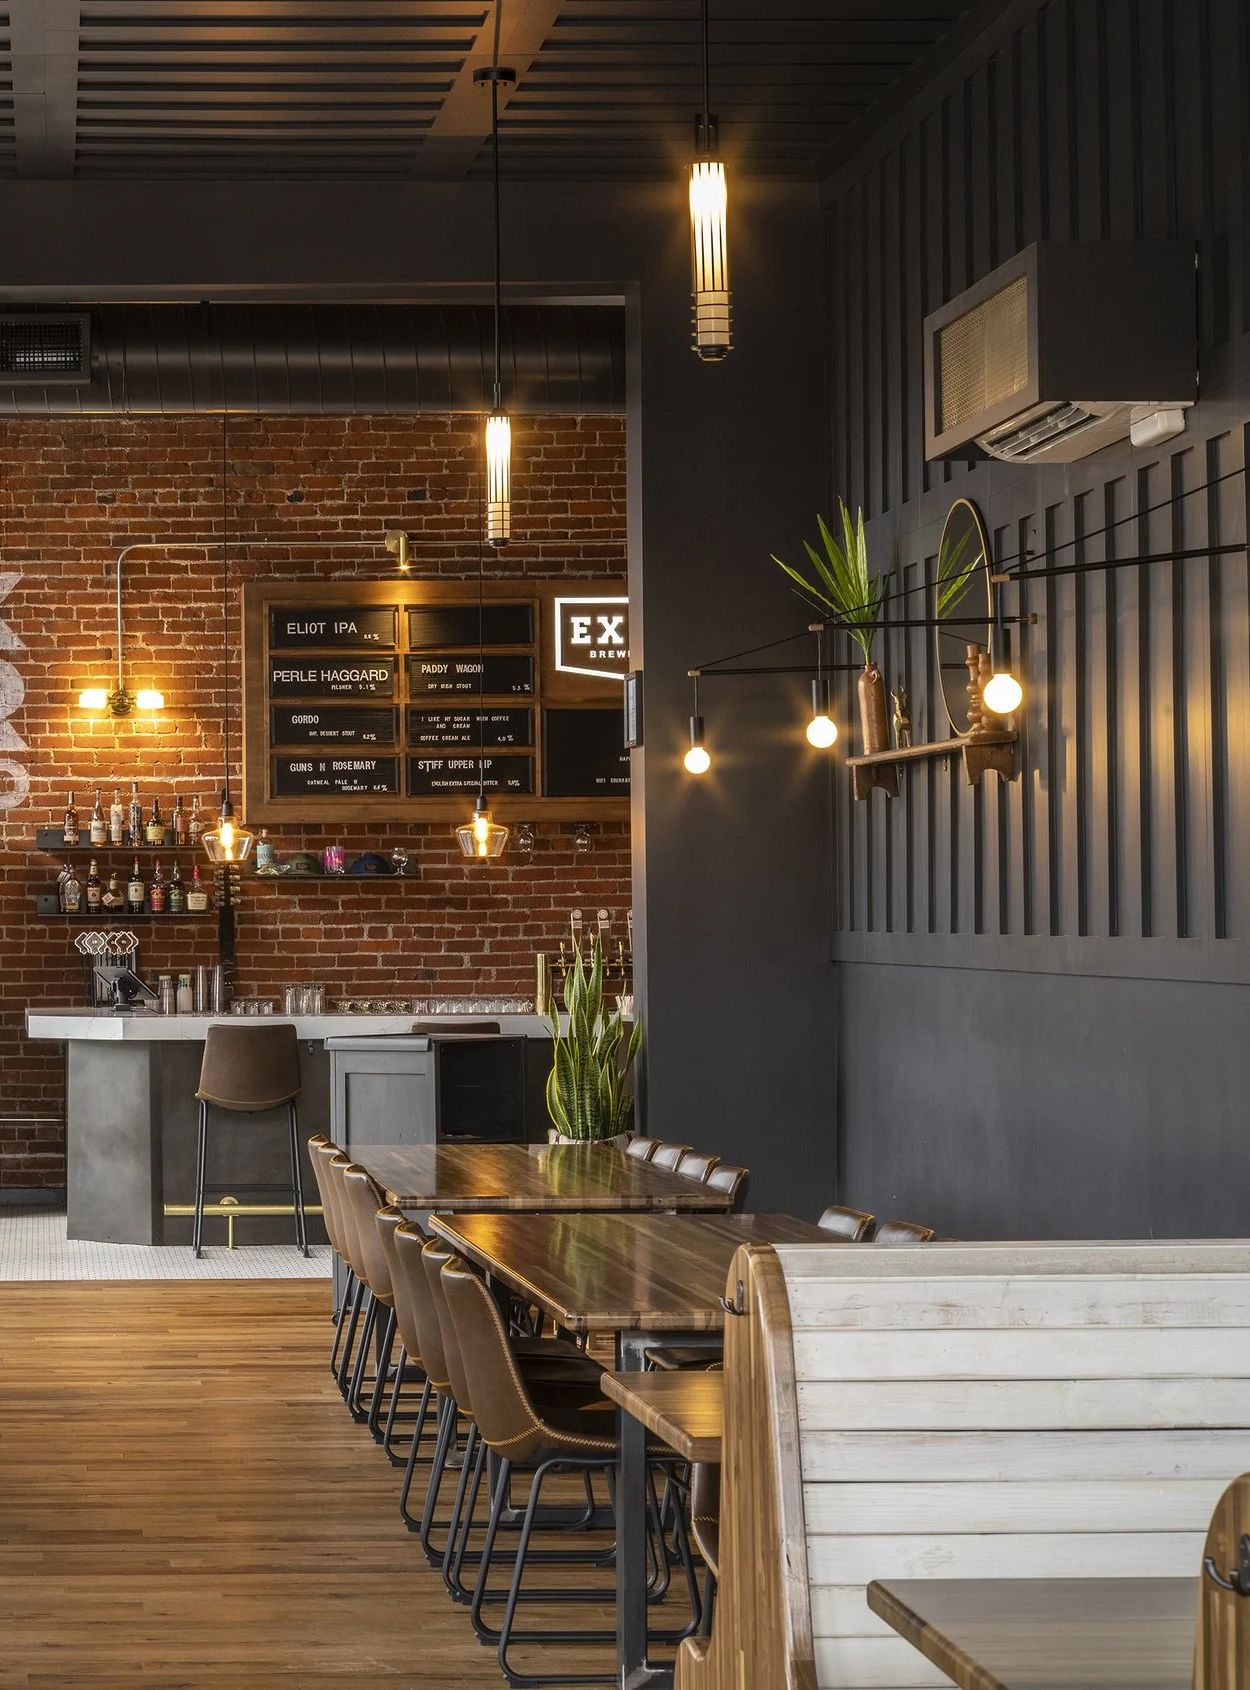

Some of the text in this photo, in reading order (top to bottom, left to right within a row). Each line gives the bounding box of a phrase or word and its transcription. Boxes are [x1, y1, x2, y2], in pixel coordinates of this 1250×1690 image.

[287, 622, 358, 634] ELIOT IPA
[570, 616, 624, 644] EX
[421, 664, 484, 674] PADDY WAGON
[273, 669, 389, 682] PERLE HAGGARD
[291, 714, 320, 724] GORDO
[290, 760, 377, 772] GUNS N ROSEMARY
[418, 760, 444, 772] STIFF
[448, 760, 474, 769] UPPER
